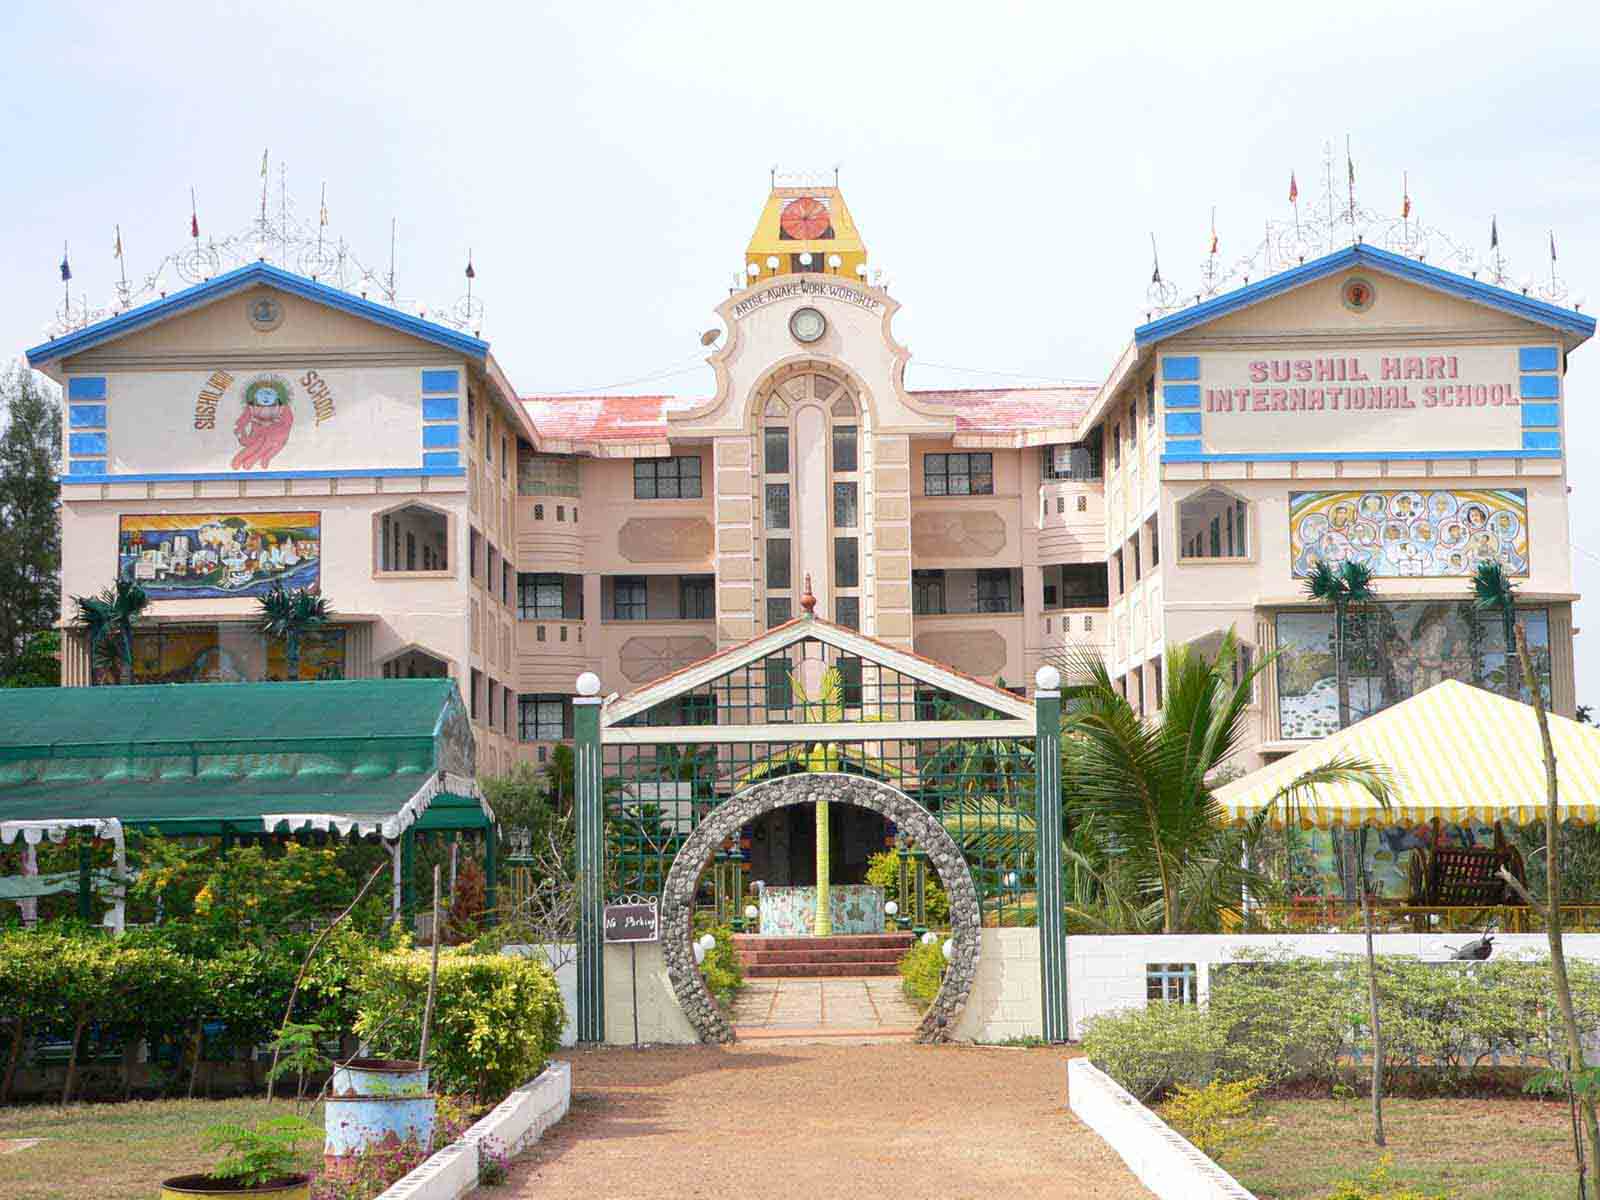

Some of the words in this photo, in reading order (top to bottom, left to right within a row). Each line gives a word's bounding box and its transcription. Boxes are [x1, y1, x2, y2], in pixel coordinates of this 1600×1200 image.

[735, 294, 767, 317] ARISE
[767, 283, 800, 299] AWAKE
[801, 282, 827, 296] WORK
[829, 285, 880, 310] WORSHIP
[1247, 356, 1370, 383] SUSHIL
[1380, 354, 1459, 381] HARI
[1205, 385, 1417, 413] INTERNATIONAL
[1422, 382, 1521, 408] SCHOOL
[606, 917, 617, 929] No
[624, 915, 656, 929] Parking
